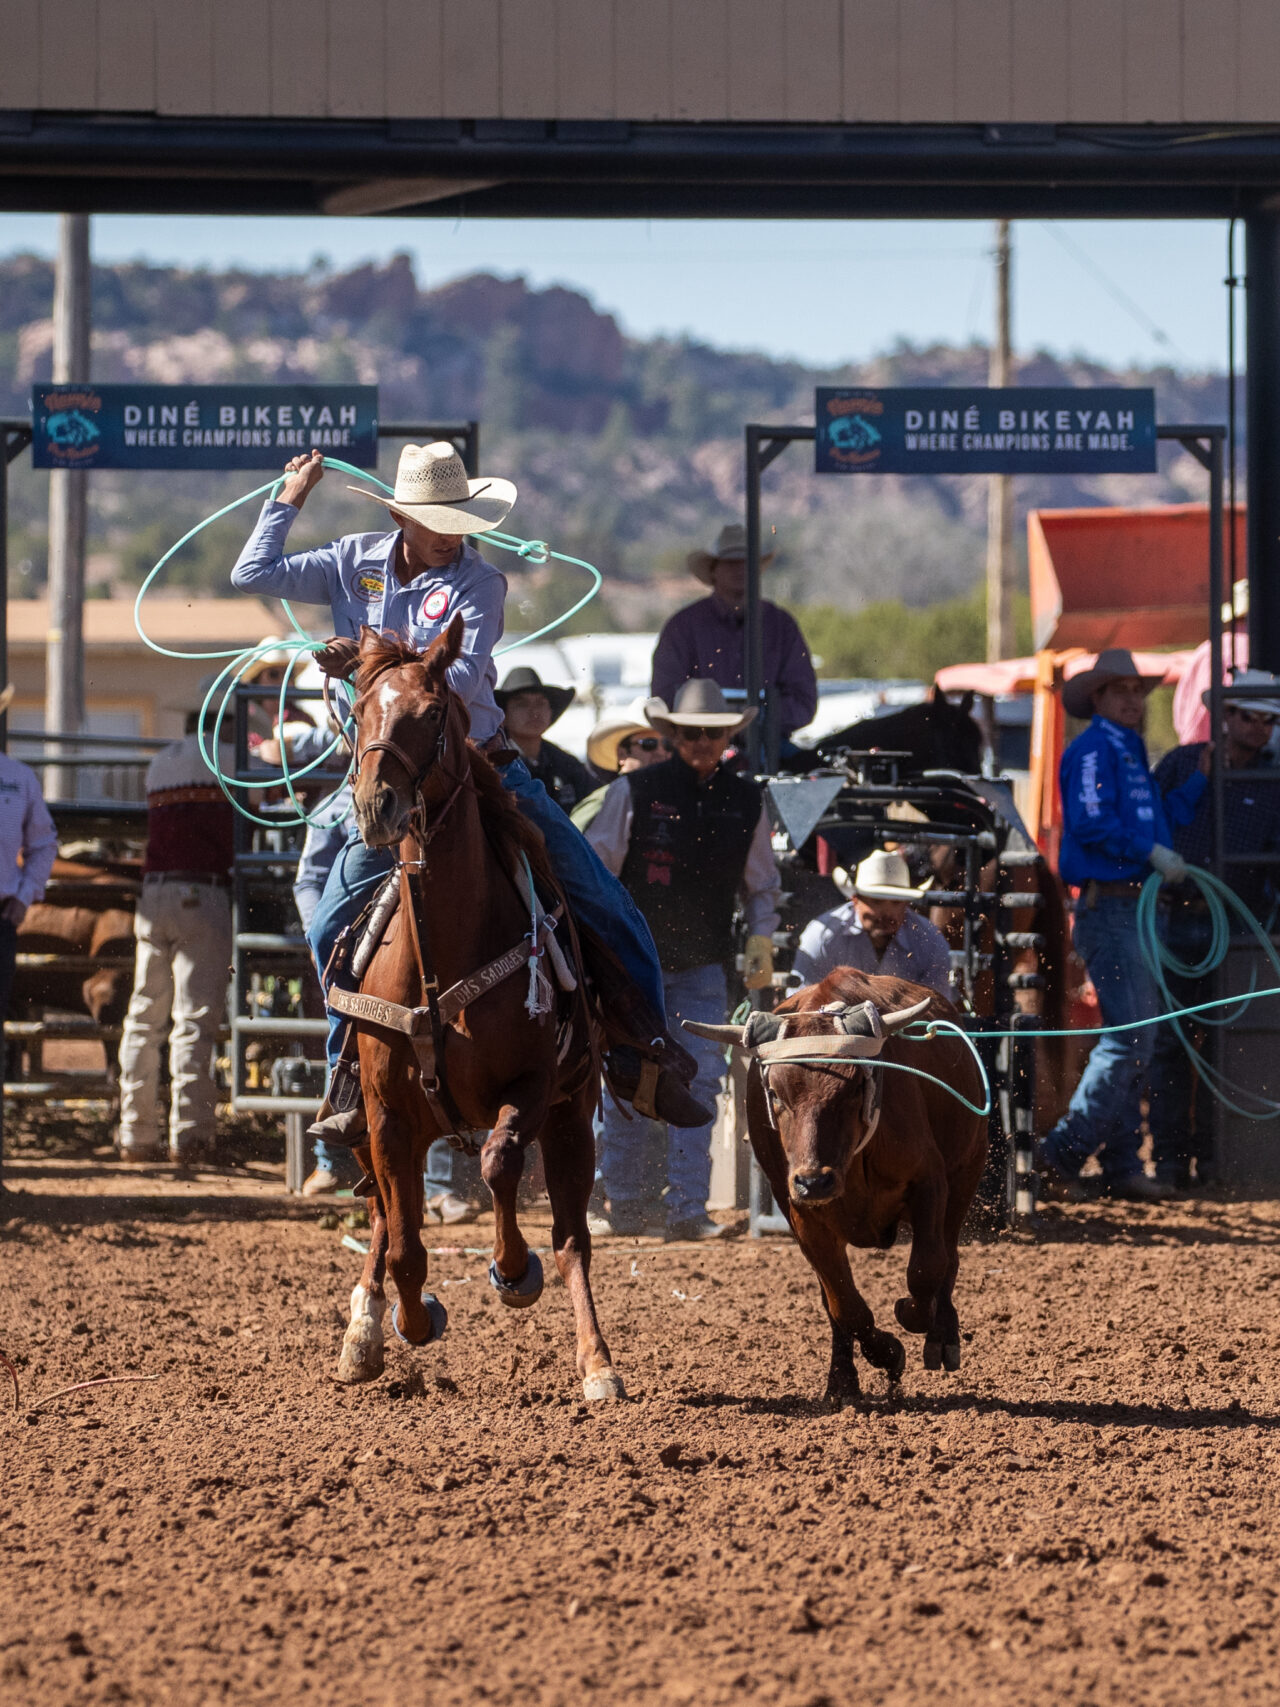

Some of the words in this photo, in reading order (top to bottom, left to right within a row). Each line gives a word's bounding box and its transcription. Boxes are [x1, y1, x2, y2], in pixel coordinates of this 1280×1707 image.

[124, 400, 200, 425] DINÉ
[220, 406, 356, 426] BIKEYAH
[905, 404, 980, 431] DINÉ
[998, 410, 1134, 431] BIKEYAH
[124, 428, 177, 447] WHERE
[183, 428, 271, 448] CHAMPIONS
[276, 429, 304, 447] ARE
[310, 428, 356, 448] MADE.
[904, 432, 958, 451] WHERE
[962, 432, 1050, 451] CHAMPIONS
[1055, 432, 1083, 450] ARE
[1087, 432, 1134, 451] MADE.
[481, 949, 524, 985] SADDLES
